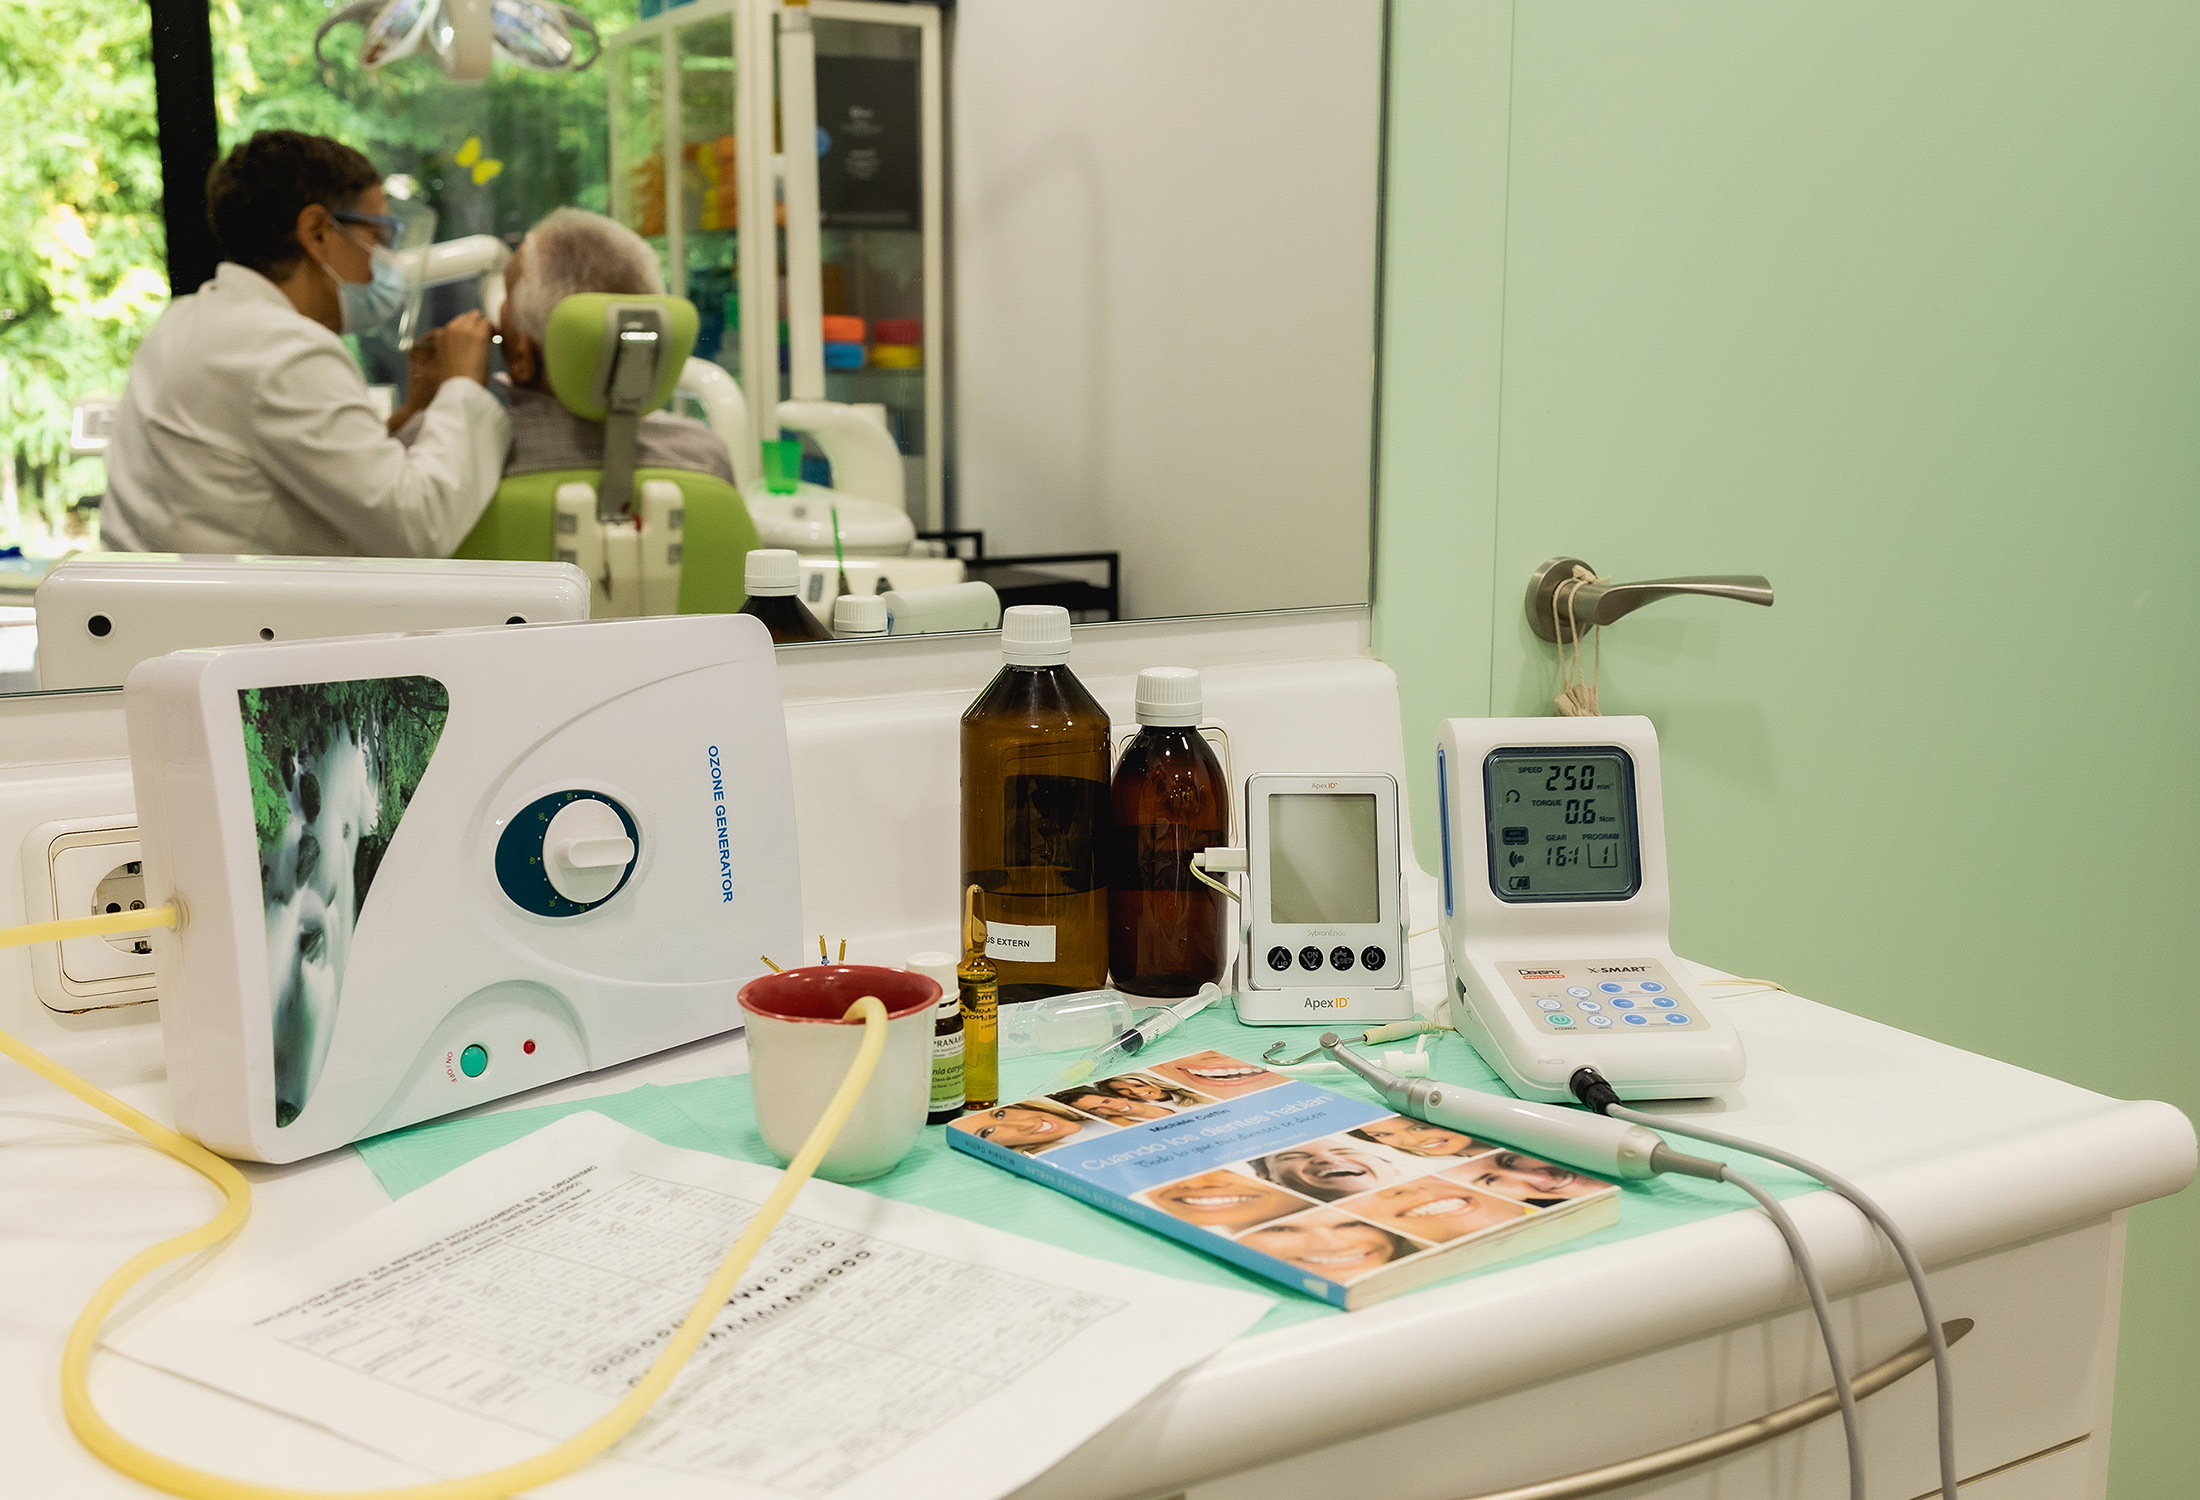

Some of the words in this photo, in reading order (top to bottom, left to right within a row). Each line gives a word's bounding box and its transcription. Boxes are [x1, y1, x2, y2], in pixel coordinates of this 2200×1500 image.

[708, 745, 725, 801] OZONE
[1518, 766, 1543, 774] SPEED
[1545, 765, 1595, 791] 250
[1565, 799, 1596, 824] 0.6
[715, 804, 733, 903] GENERATOR
[1546, 846, 1579, 866] 16:1
[1602, 846, 1609, 864] 1
[996, 937, 1030, 947] EXTERN
[1306, 929, 1347, 937] SybronEndo
[1307, 951, 1319, 959] DN
[1304, 997, 1334, 1010] Apex
[1081, 1143, 1167, 1170] Cuando
[1161, 1133, 1200, 1146] los
[1200, 1114, 1271, 1137] dientes
[1264, 1096, 1334, 1118] hablan
